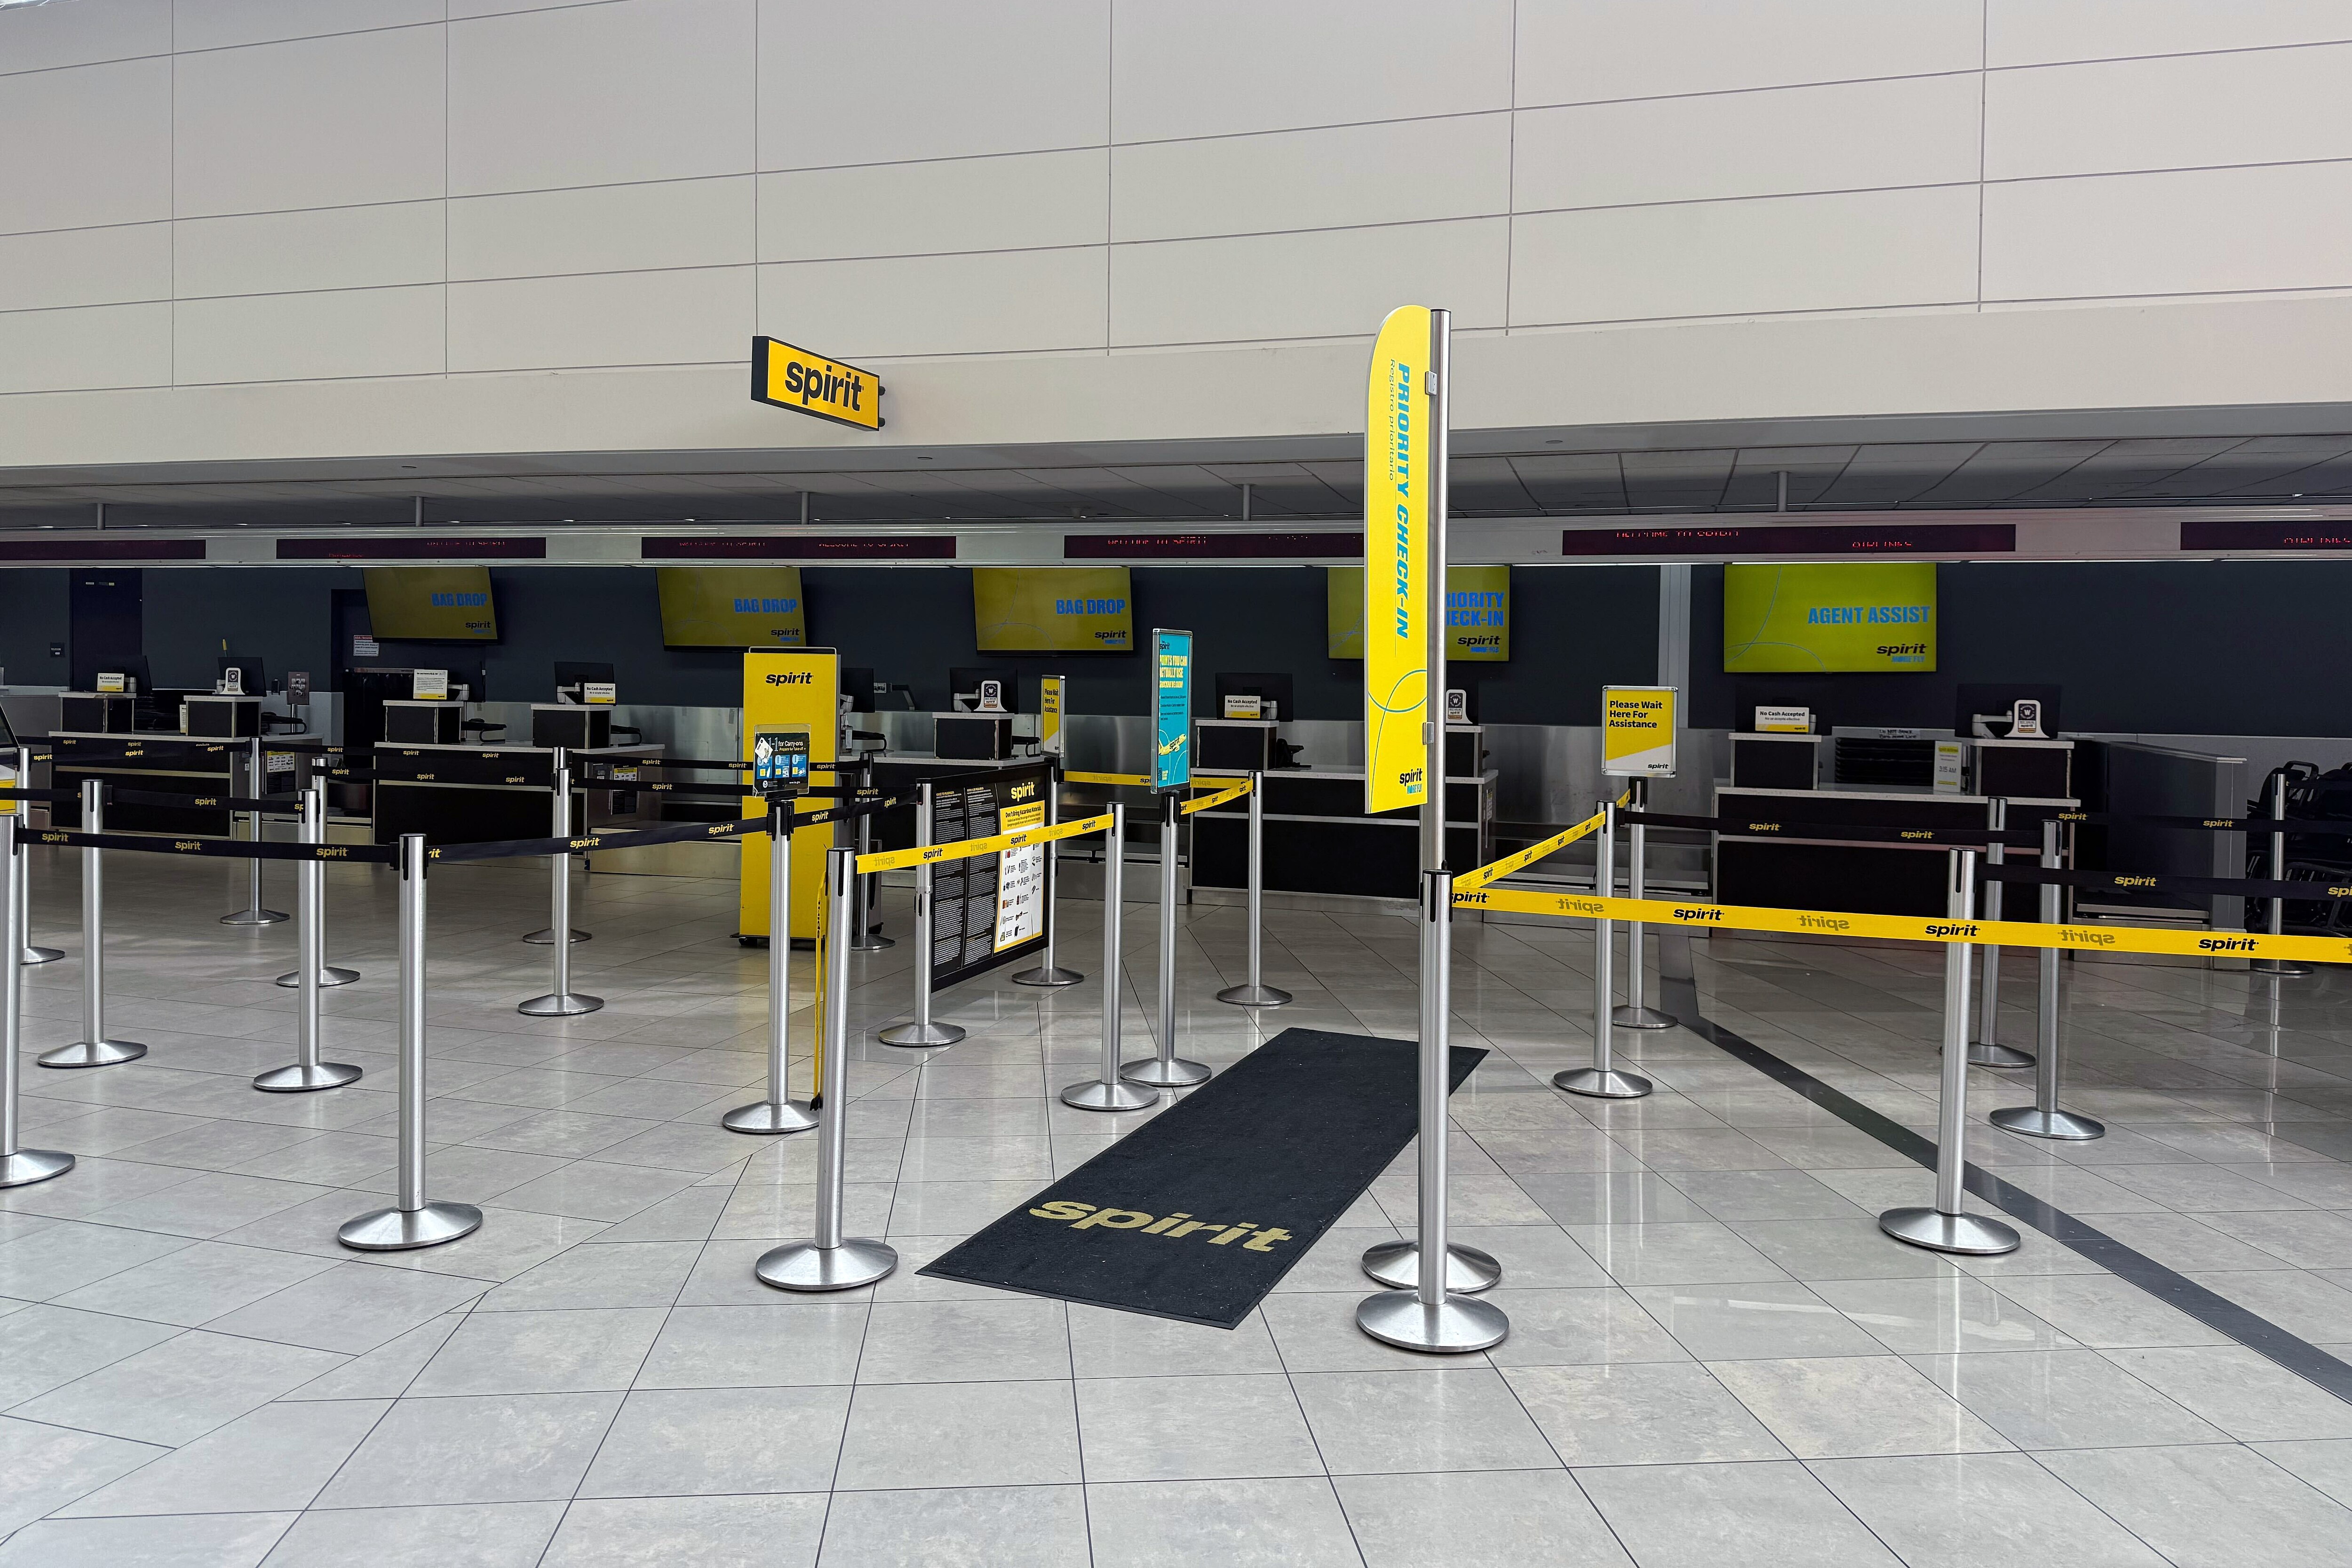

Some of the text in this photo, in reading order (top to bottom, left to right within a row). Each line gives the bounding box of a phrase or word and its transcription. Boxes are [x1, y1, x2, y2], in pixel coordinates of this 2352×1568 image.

[785, 361, 862, 412] spirit
[1397, 363, 1410, 639] PRIORITY CHECK-IN
[432, 593, 487, 606] BAG DROP
[734, 598, 797, 613] BAG DROP
[1446, 592, 1504, 608] IORITY
[1056, 599, 1126, 614] BAG DROP
[1446, 610, 1504, 627] ECK-IN
[1808, 605, 1931, 624] AGENT ASSIST
[771, 628, 800, 637] spirit
[1095, 630, 1126, 639] spirit
[1457, 635, 1500, 646] spirit
[1876, 644, 1927, 656] spirit
[765, 672, 813, 687] spirit
[1610, 700, 1663, 709] Please Wait
[1609, 719, 1657, 728] Assistance
[1399, 768, 1423, 787] spirit
[1011, 781, 1034, 802] spirit
[884, 796, 897, 808] spirit
[812, 811, 829, 823] spirit
[708, 823, 734, 835] spirit
[1082, 820, 1096, 831] spirit
[1749, 823, 1780, 831] spirit
[42, 832, 69, 842] spirit
[570, 837, 600, 849] spirit
[1010, 834, 1027, 846] spirit
[175, 841, 201, 851] spirit
[317, 847, 347, 858] spirit
[923, 848, 944, 860] spirit
[2114, 876, 2157, 887] spirit
[2328, 886, 2352, 897] spi
[1673, 908, 1722, 921] spirit
[1925, 923, 1979, 938] spirit
[2198, 937, 2257, 952] spirit
[1029, 1201, 1293, 1252] spirit
